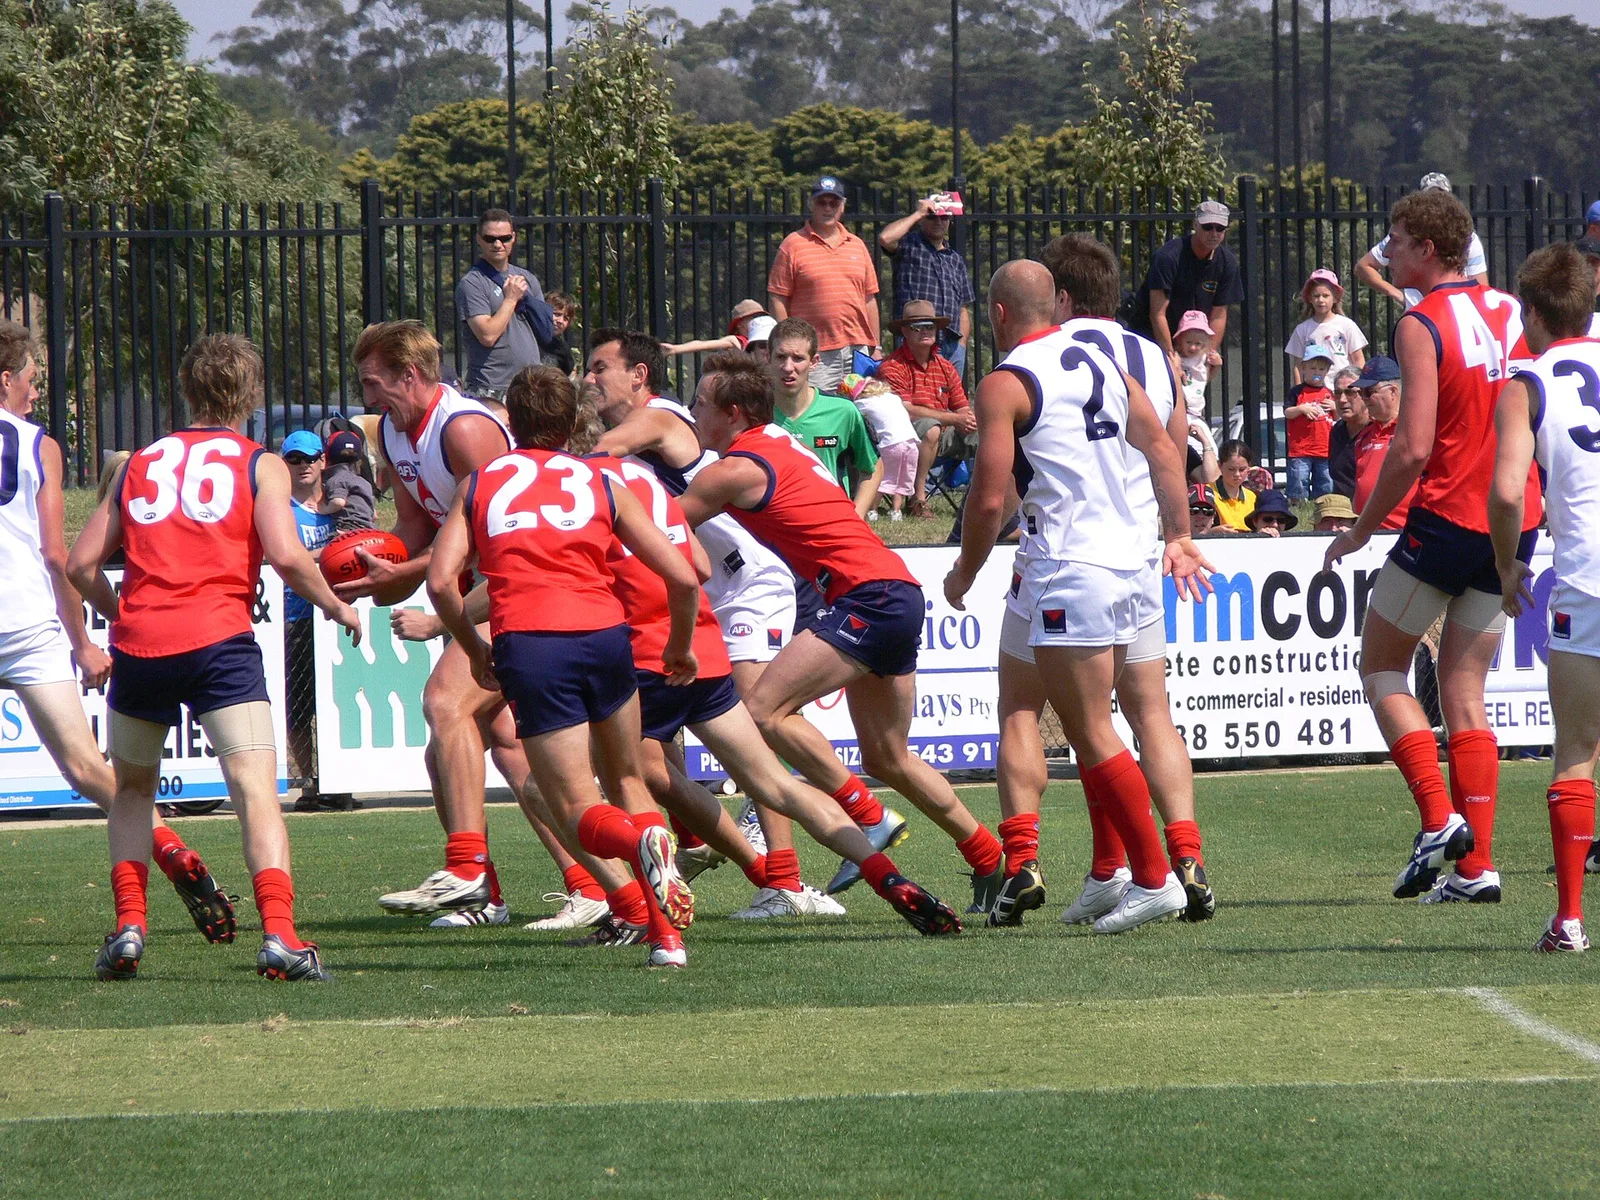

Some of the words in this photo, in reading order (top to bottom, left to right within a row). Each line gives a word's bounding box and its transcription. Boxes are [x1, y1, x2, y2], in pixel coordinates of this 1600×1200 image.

[1448, 289, 1534, 382] 42
[1060, 346, 1120, 442] 2
[128, 436, 241, 525] 36
[398, 463, 416, 478] AFL
[484, 453, 595, 538] 23
[731, 625, 751, 635] AFL
[969, 697, 992, 720] Pty
[1187, 687, 1284, 711] commercial
[1525, 700, 1552, 726] RE
[1225, 720, 1281, 749] 550
[1297, 717, 1352, 746] 481
[701, 752, 725, 772] PE
[962, 741, 999, 763] 91
